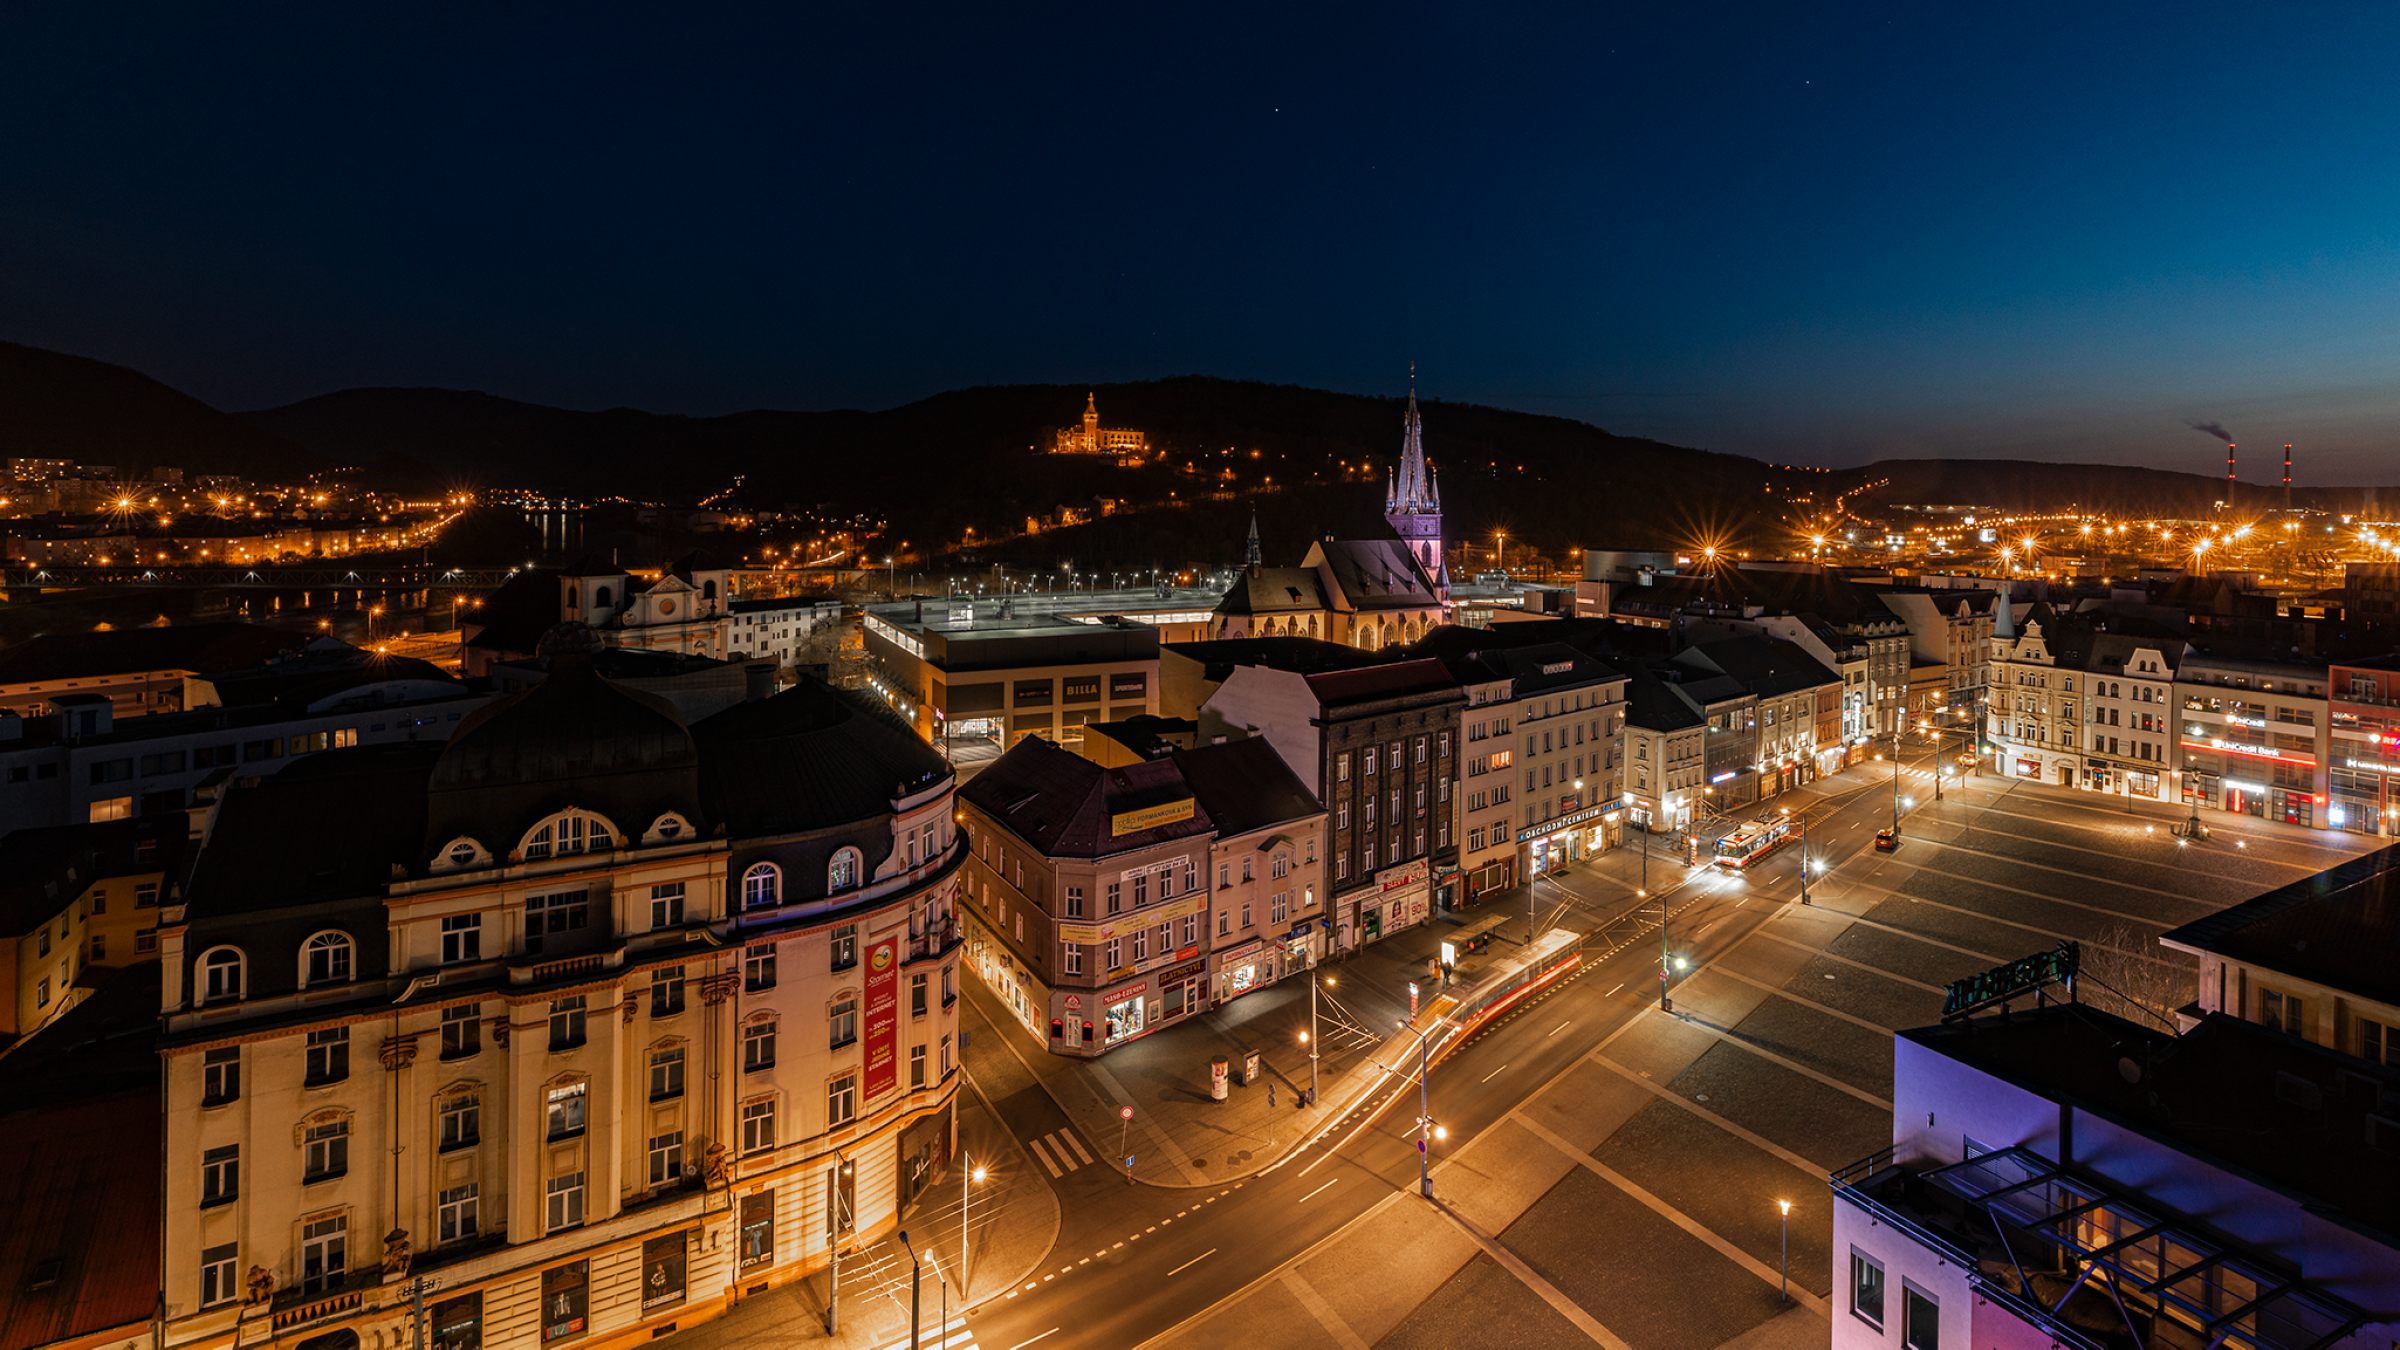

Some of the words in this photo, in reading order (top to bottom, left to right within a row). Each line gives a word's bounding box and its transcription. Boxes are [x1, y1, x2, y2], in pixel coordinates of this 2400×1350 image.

[1066, 684, 1098, 695] BILLA
[2235, 717, 2266, 728] UniCredit
[2221, 741, 2257, 753] UniCredit
[2258, 746, 2280, 756] Bank
[1182, 804, 1193, 812] SYN
[1525, 818, 1566, 838] OBCHODNÍ
[1567, 809, 1599, 825] CENTRUM
[1412, 903, 1427, 916] 90%
[866, 999, 896, 1017] INTERNET
[868, 1055, 893, 1072] STARNET
